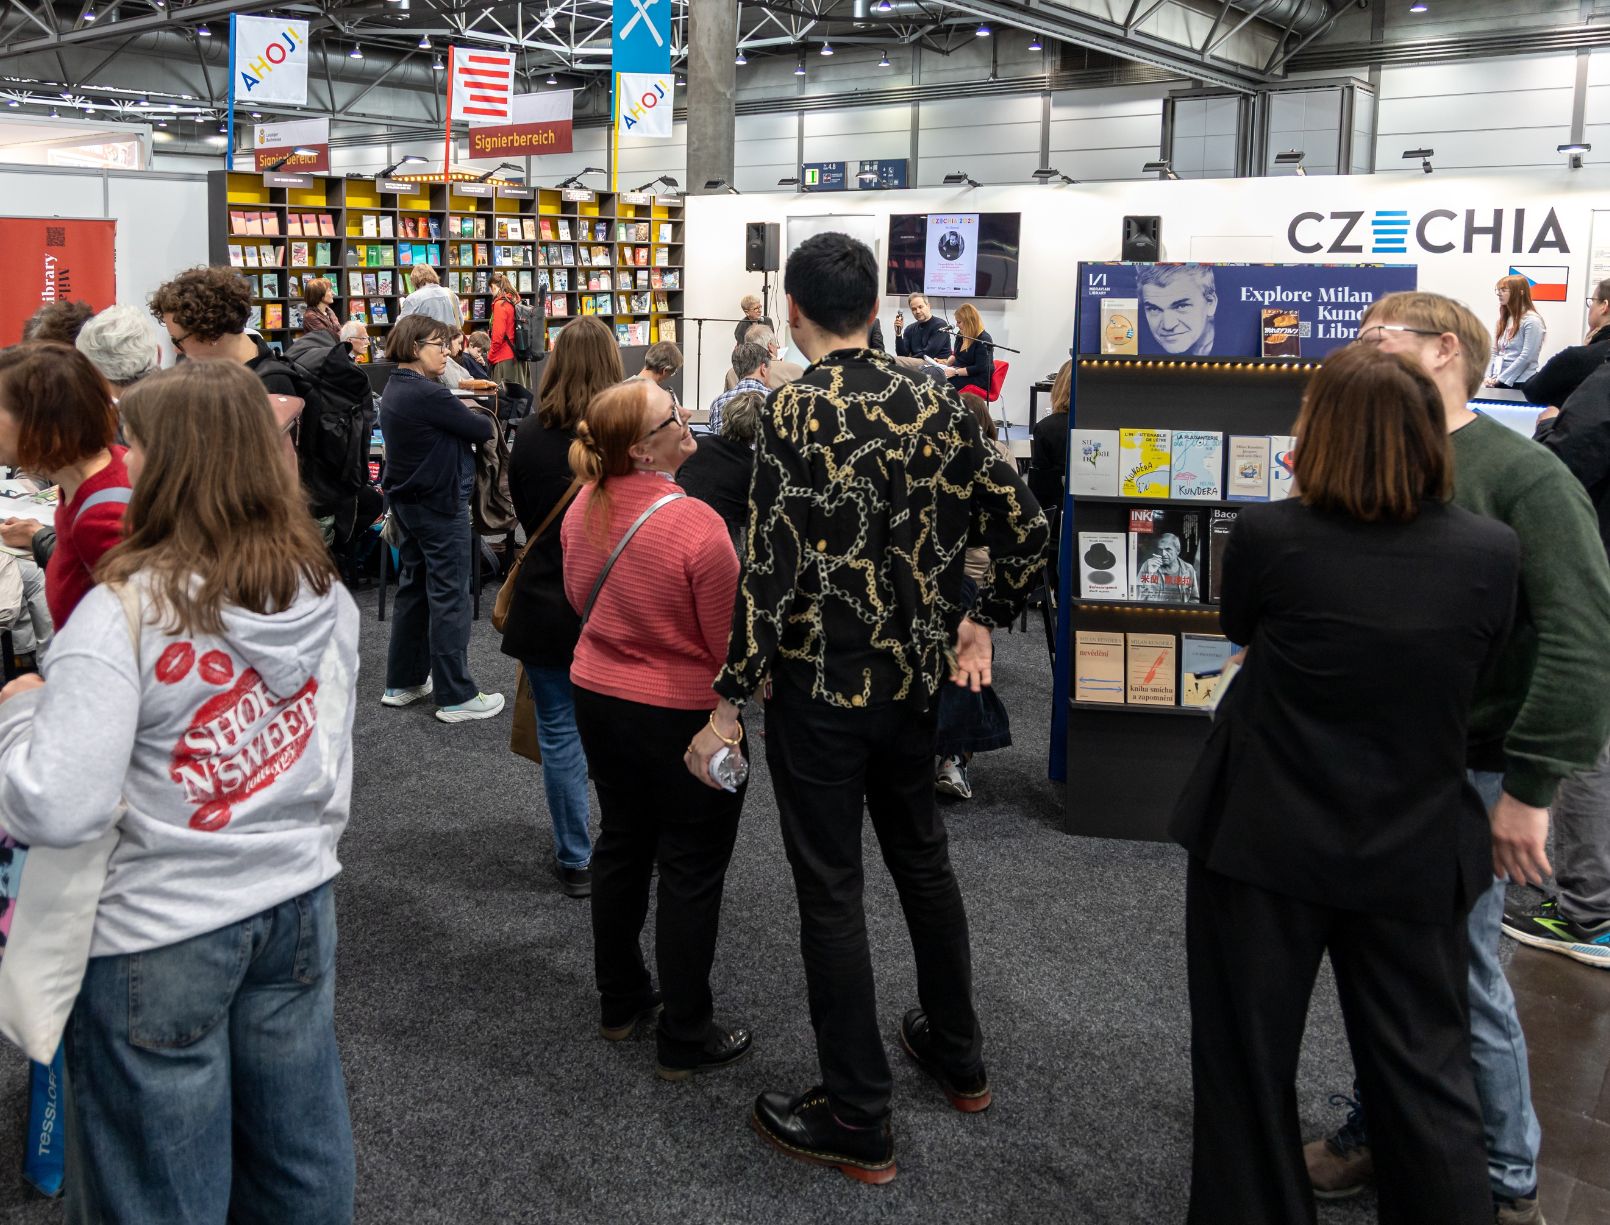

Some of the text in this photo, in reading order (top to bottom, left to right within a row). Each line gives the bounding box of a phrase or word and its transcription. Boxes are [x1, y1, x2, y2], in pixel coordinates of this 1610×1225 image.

[241, 26, 303, 92] AHOJ!
[623, 79, 670, 130] AHOJ!
[475, 129, 555, 152] Signierbereich
[1287, 206, 1571, 254] CZECHIA
[41, 252, 58, 304] ibrary
[1240, 286, 1373, 305] Explore Milan
[1317, 322, 1359, 339] Libr
[1178, 485, 1218, 496] KUNDERA
[1131, 510, 1152, 521] INK
[1214, 509, 1238, 519] Baco
